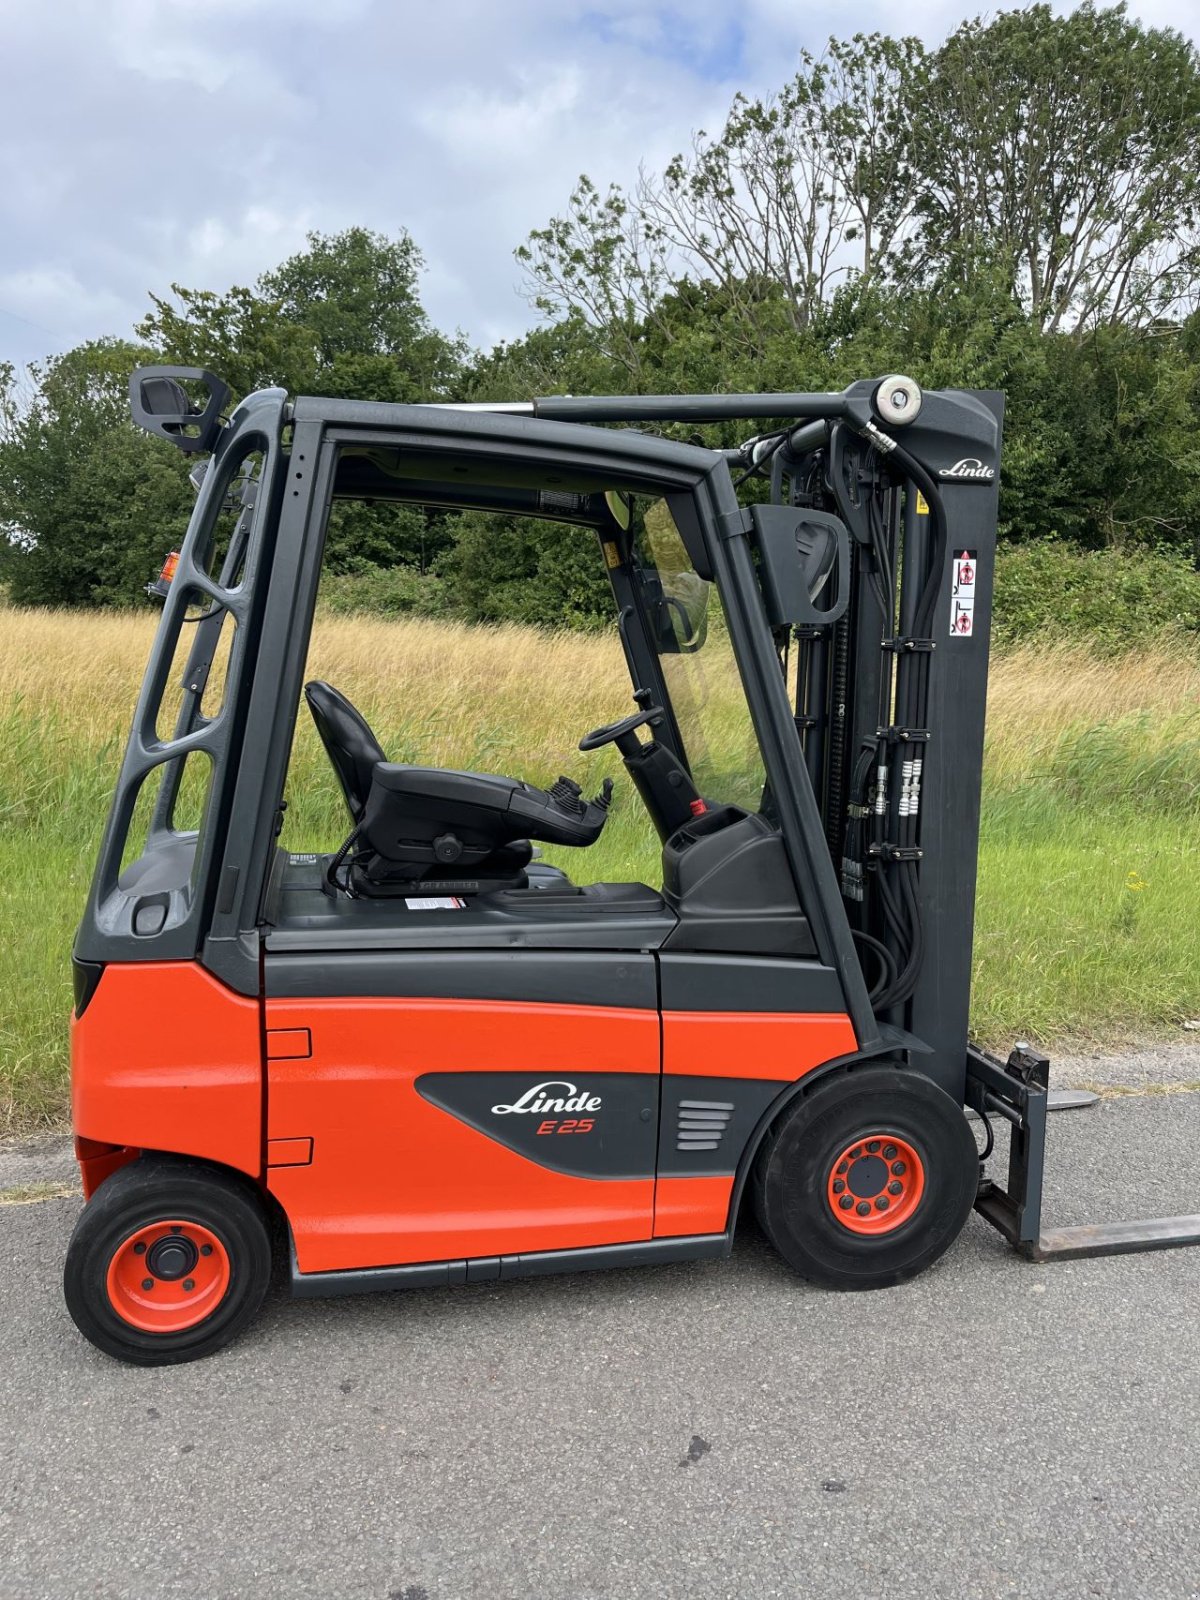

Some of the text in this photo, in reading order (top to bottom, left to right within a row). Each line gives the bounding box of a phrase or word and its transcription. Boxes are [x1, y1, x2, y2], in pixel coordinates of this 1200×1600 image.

[939, 458, 995, 478] Linde
[491, 1081, 602, 1114] Linde
[536, 1118, 596, 1135] E 25
